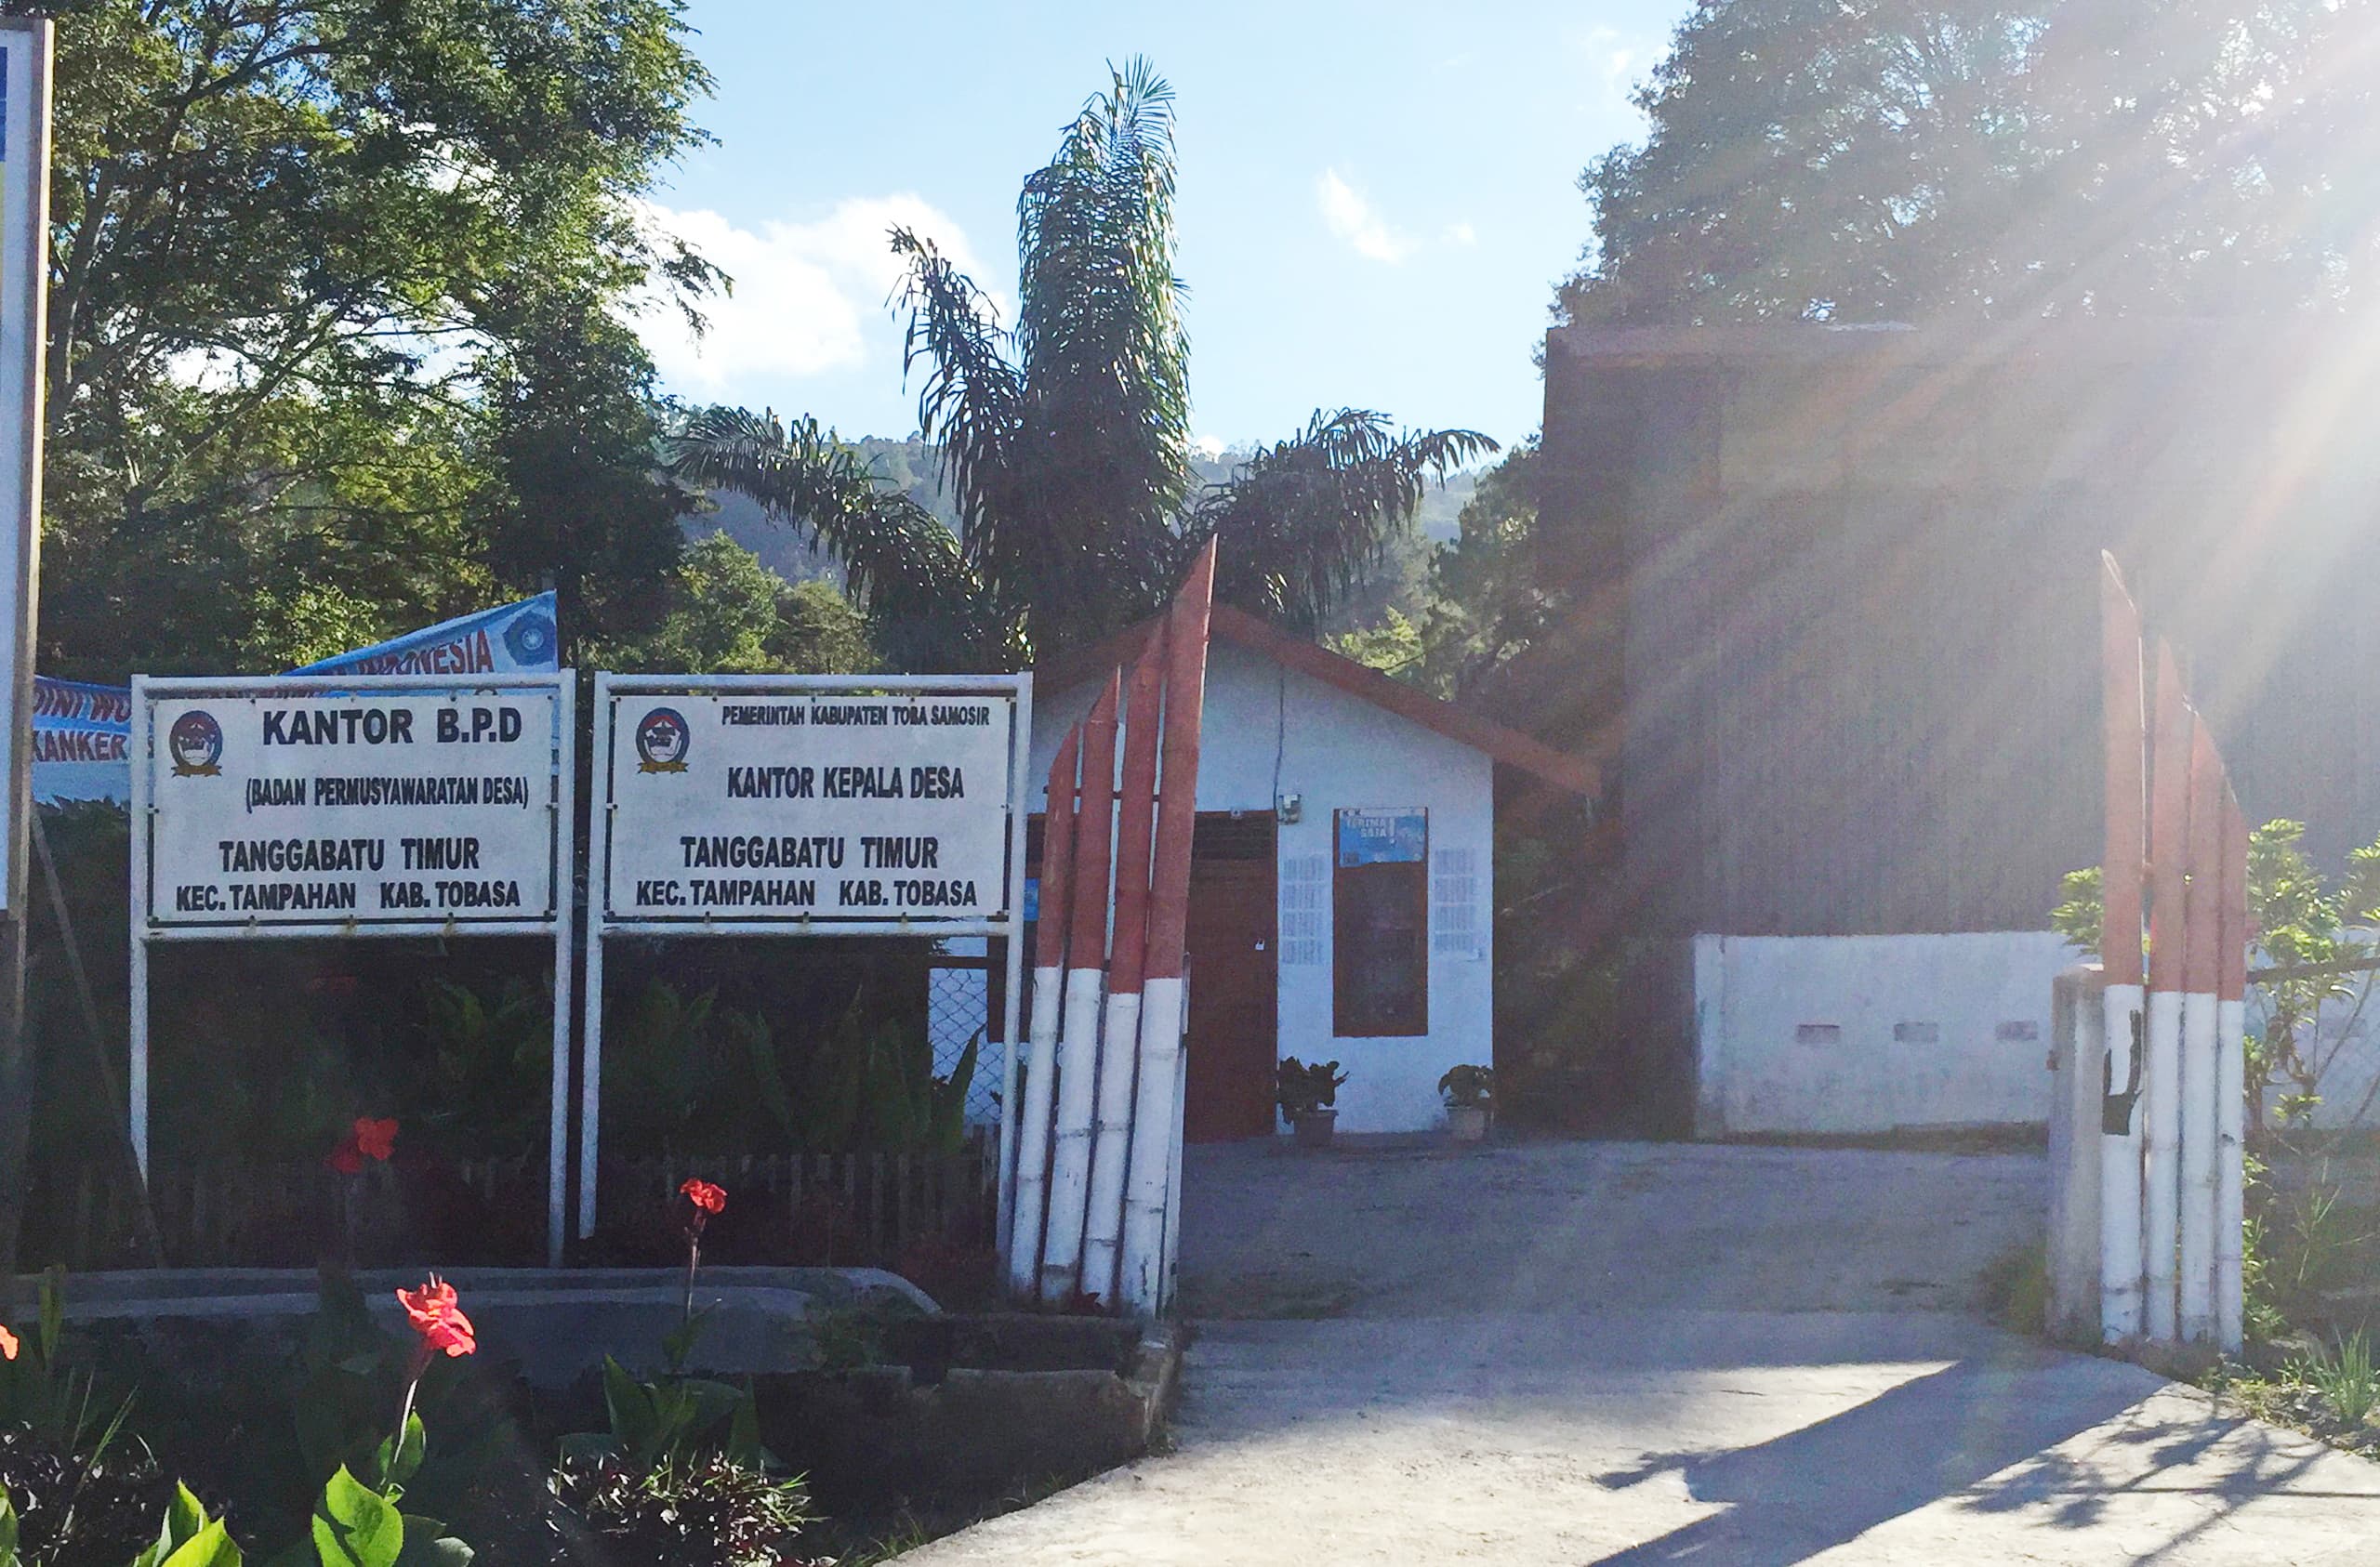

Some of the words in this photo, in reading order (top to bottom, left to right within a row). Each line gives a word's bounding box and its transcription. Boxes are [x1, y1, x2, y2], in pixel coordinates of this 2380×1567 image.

[263, 709, 413, 745] KANTOR
[437, 706, 522, 744] B.P.D
[722, 705, 804, 725] PEMERINTAH
[811, 705, 888, 725] KABUPATEN
[892, 705, 928, 725] TOBA
[931, 705, 989, 725] SAMOSIR
[246, 778, 306, 813] (BADAN
[314, 777, 478, 806] PERMUSYAWARATAN
[483, 777, 528, 810] DESA)
[728, 767, 813, 798] KANTOR
[824, 767, 903, 798] KEPALA
[910, 766, 964, 799] DESA
[219, 838, 384, 872] TANGGABATU
[401, 837, 479, 870] TIMUR
[680, 836, 844, 868] TANGGABATU
[861, 836, 938, 869] TIMUR
